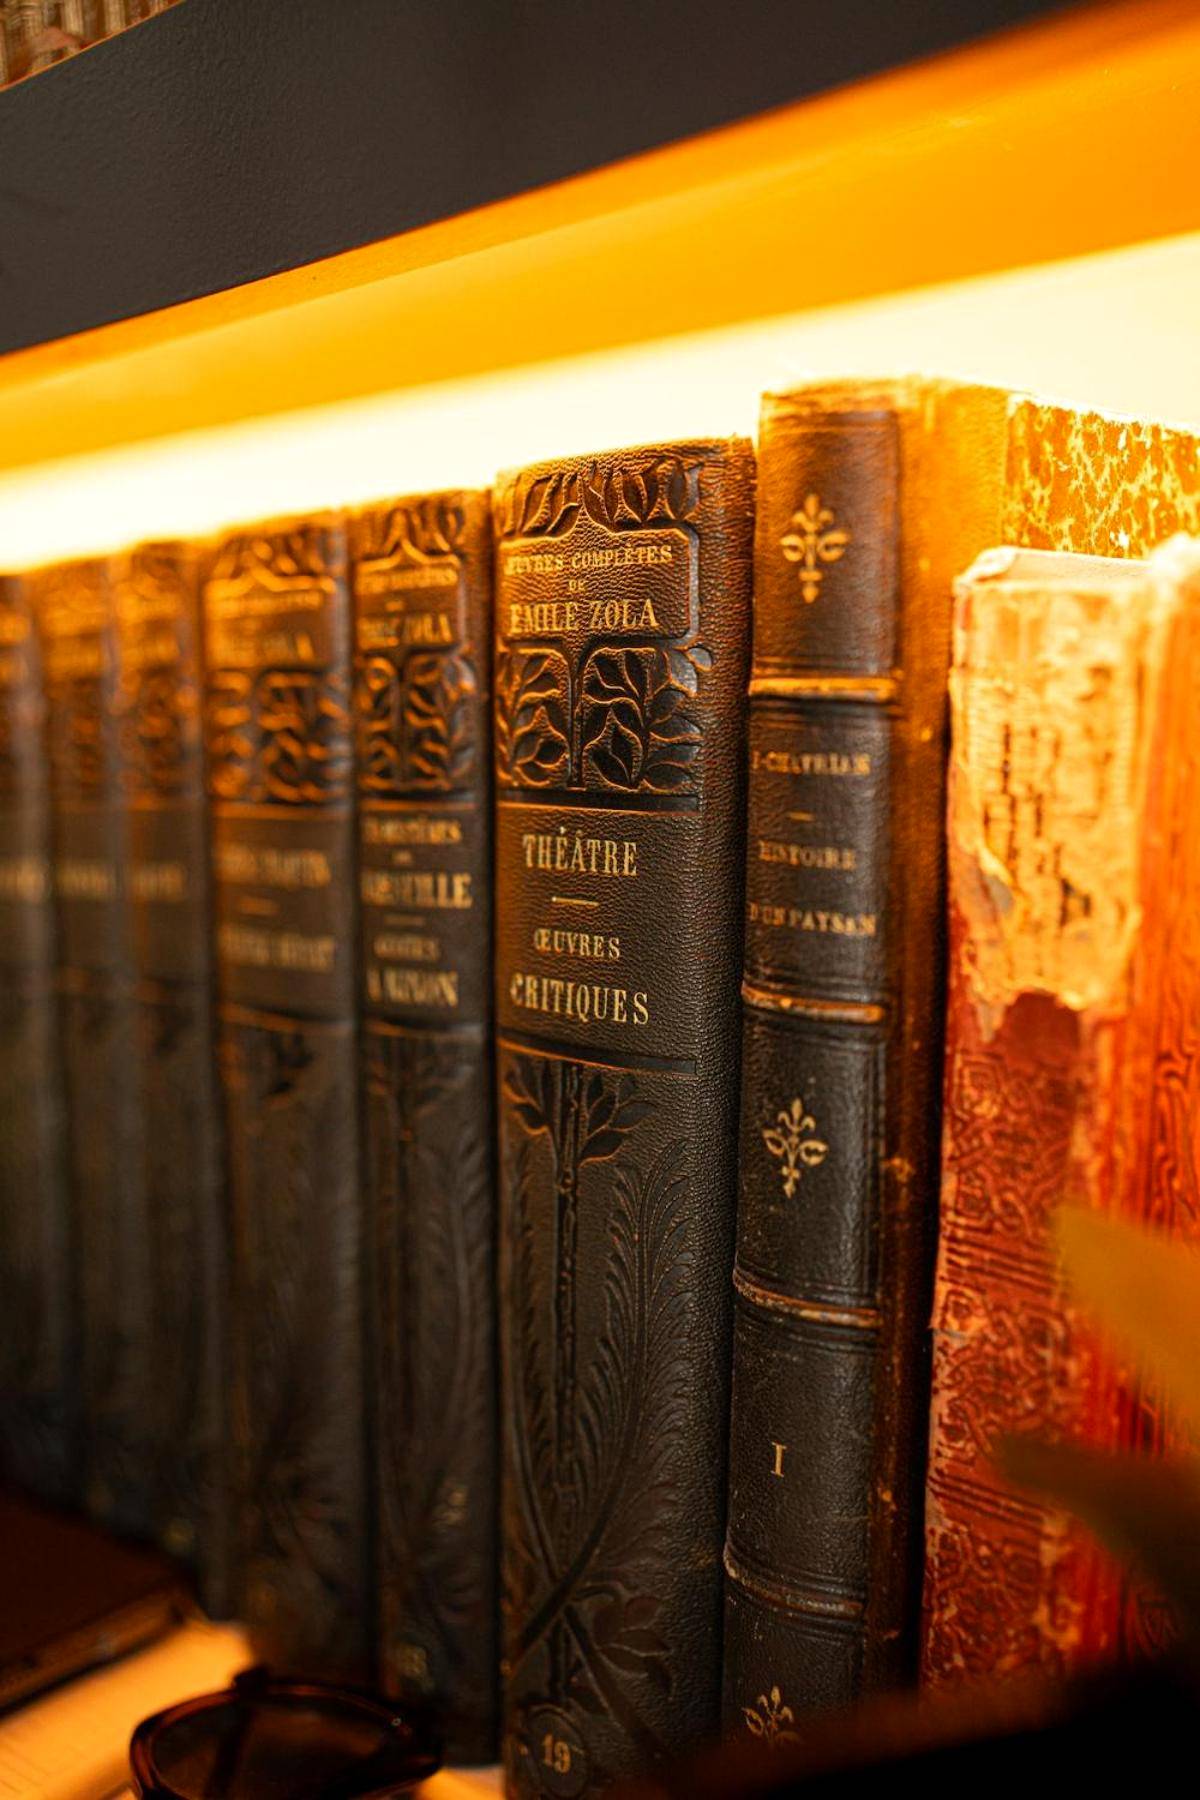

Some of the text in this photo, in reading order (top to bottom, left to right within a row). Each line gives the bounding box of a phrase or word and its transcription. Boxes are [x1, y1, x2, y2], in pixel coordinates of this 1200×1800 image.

[589, 598, 660, 630] ZOLA
[522, 825, 637, 877] THÉÂTRE
[533, 928, 621, 961] ŒUVRES
[509, 972, 650, 1026] CRITIQUES
[770, 1441, 787, 1478] I
[543, 1732, 571, 1774] 19
